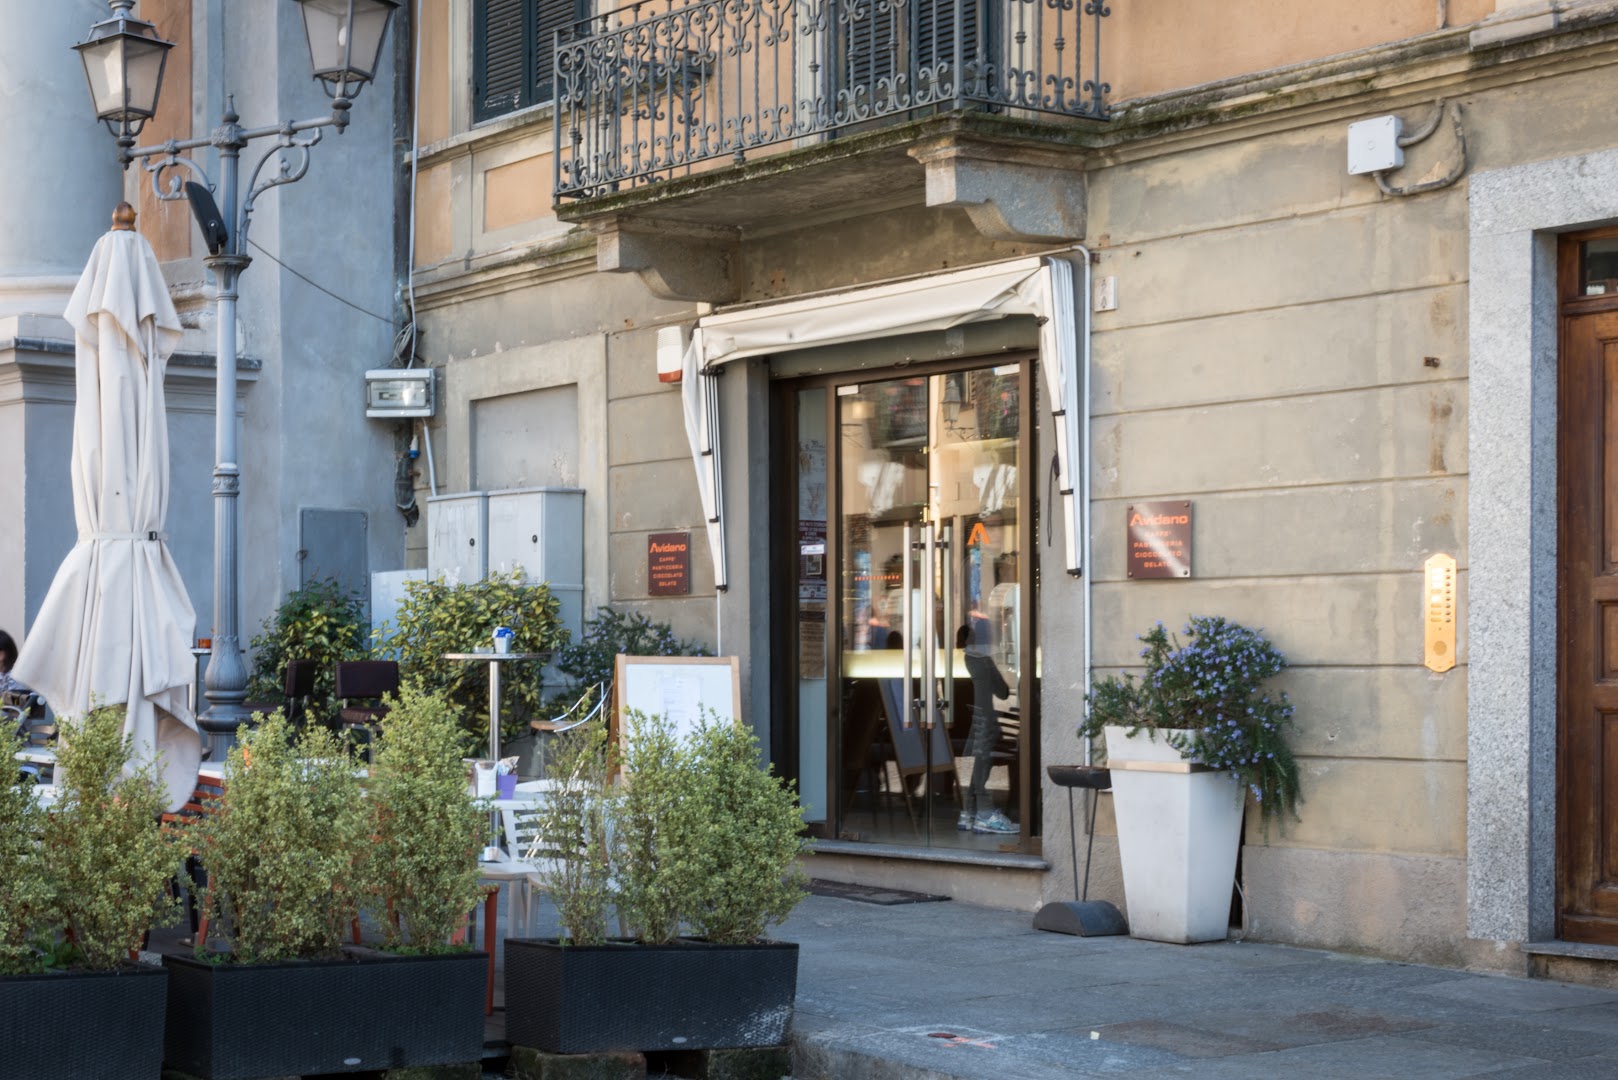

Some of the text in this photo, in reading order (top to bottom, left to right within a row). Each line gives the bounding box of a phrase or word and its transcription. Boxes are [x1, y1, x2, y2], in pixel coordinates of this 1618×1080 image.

[1130, 513, 1189, 527] Avidano
[650, 542, 687, 553] Avidano
[1134, 550, 1183, 558] CIOCCOATO
[1143, 560, 1173, 568] GELATO
